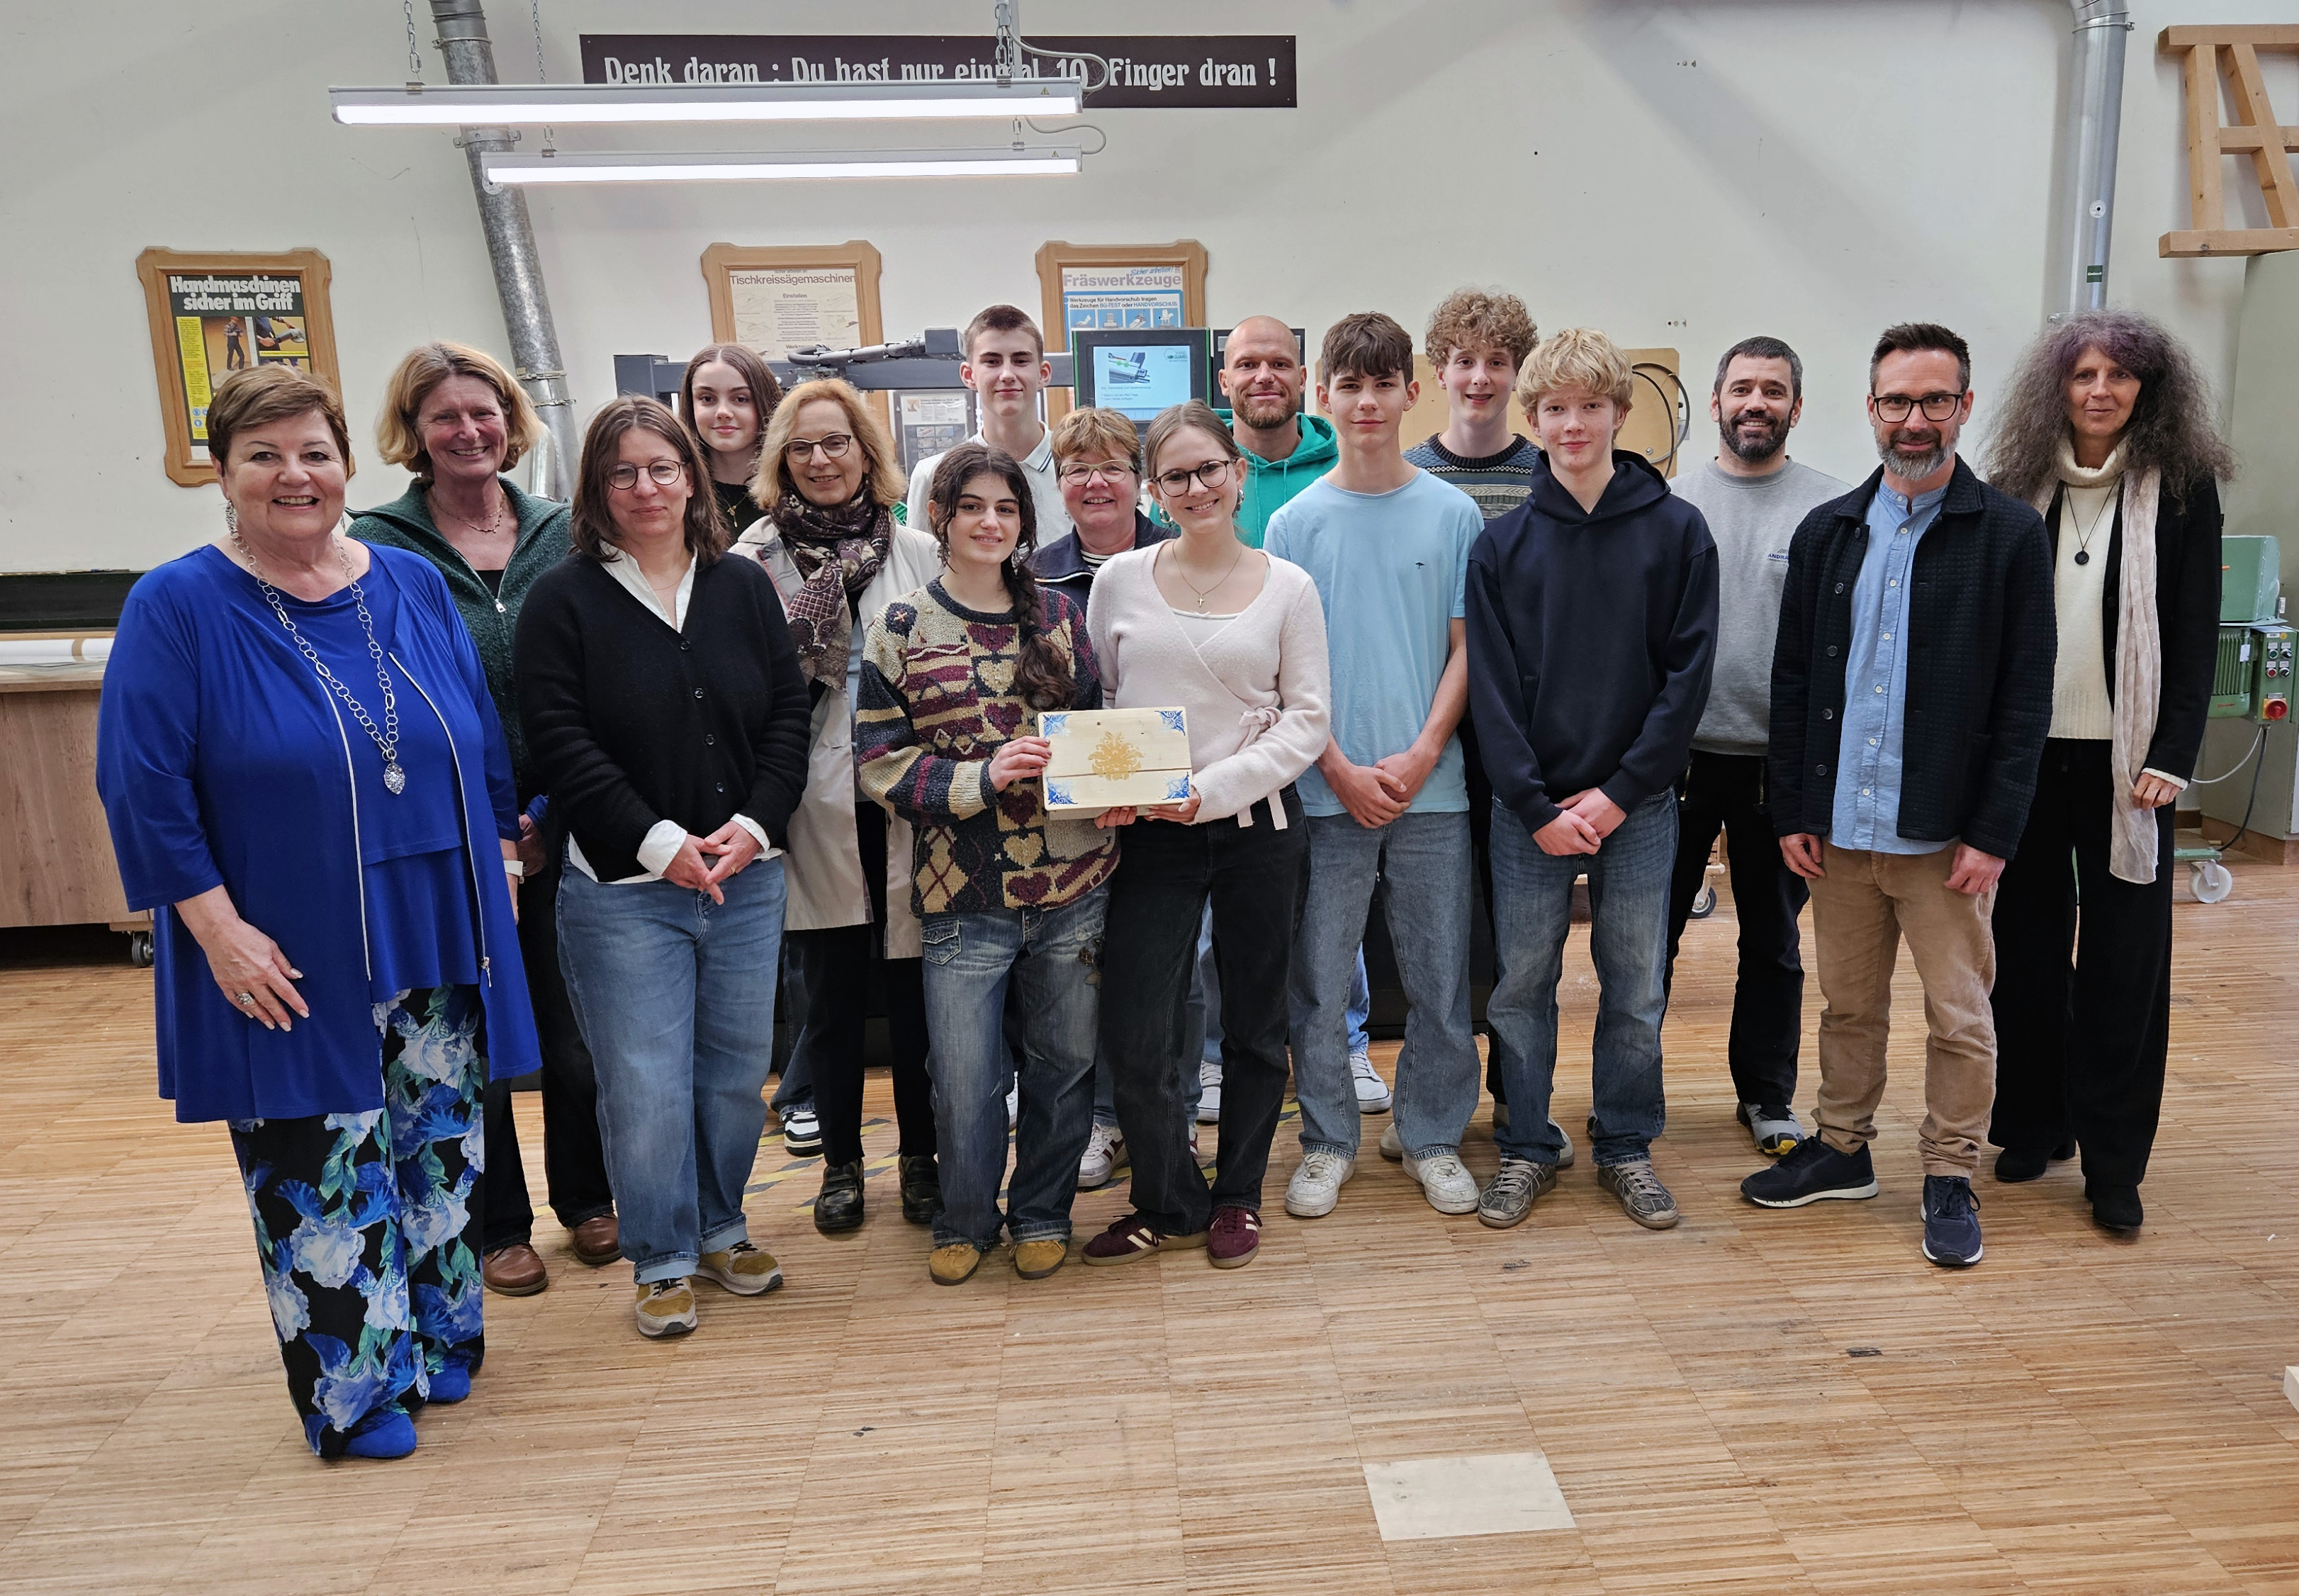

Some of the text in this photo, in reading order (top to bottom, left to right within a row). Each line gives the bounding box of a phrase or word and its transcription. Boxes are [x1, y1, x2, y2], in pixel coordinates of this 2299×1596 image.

[605, 57, 673, 84] Denk
[684, 57, 759, 83] daran
[791, 57, 825, 82] Du
[835, 57, 889, 81] hast
[901, 62, 944, 81] nur
[1056, 58, 1089, 89] 10
[1108, 58, 1190, 91] Finger
[1199, 58, 1257, 86] dran
[170, 275, 301, 293] Handmaschinen
[1063, 274, 1181, 288] Fräswerkzeuge
[184, 293, 293, 310] sicher im Griff
